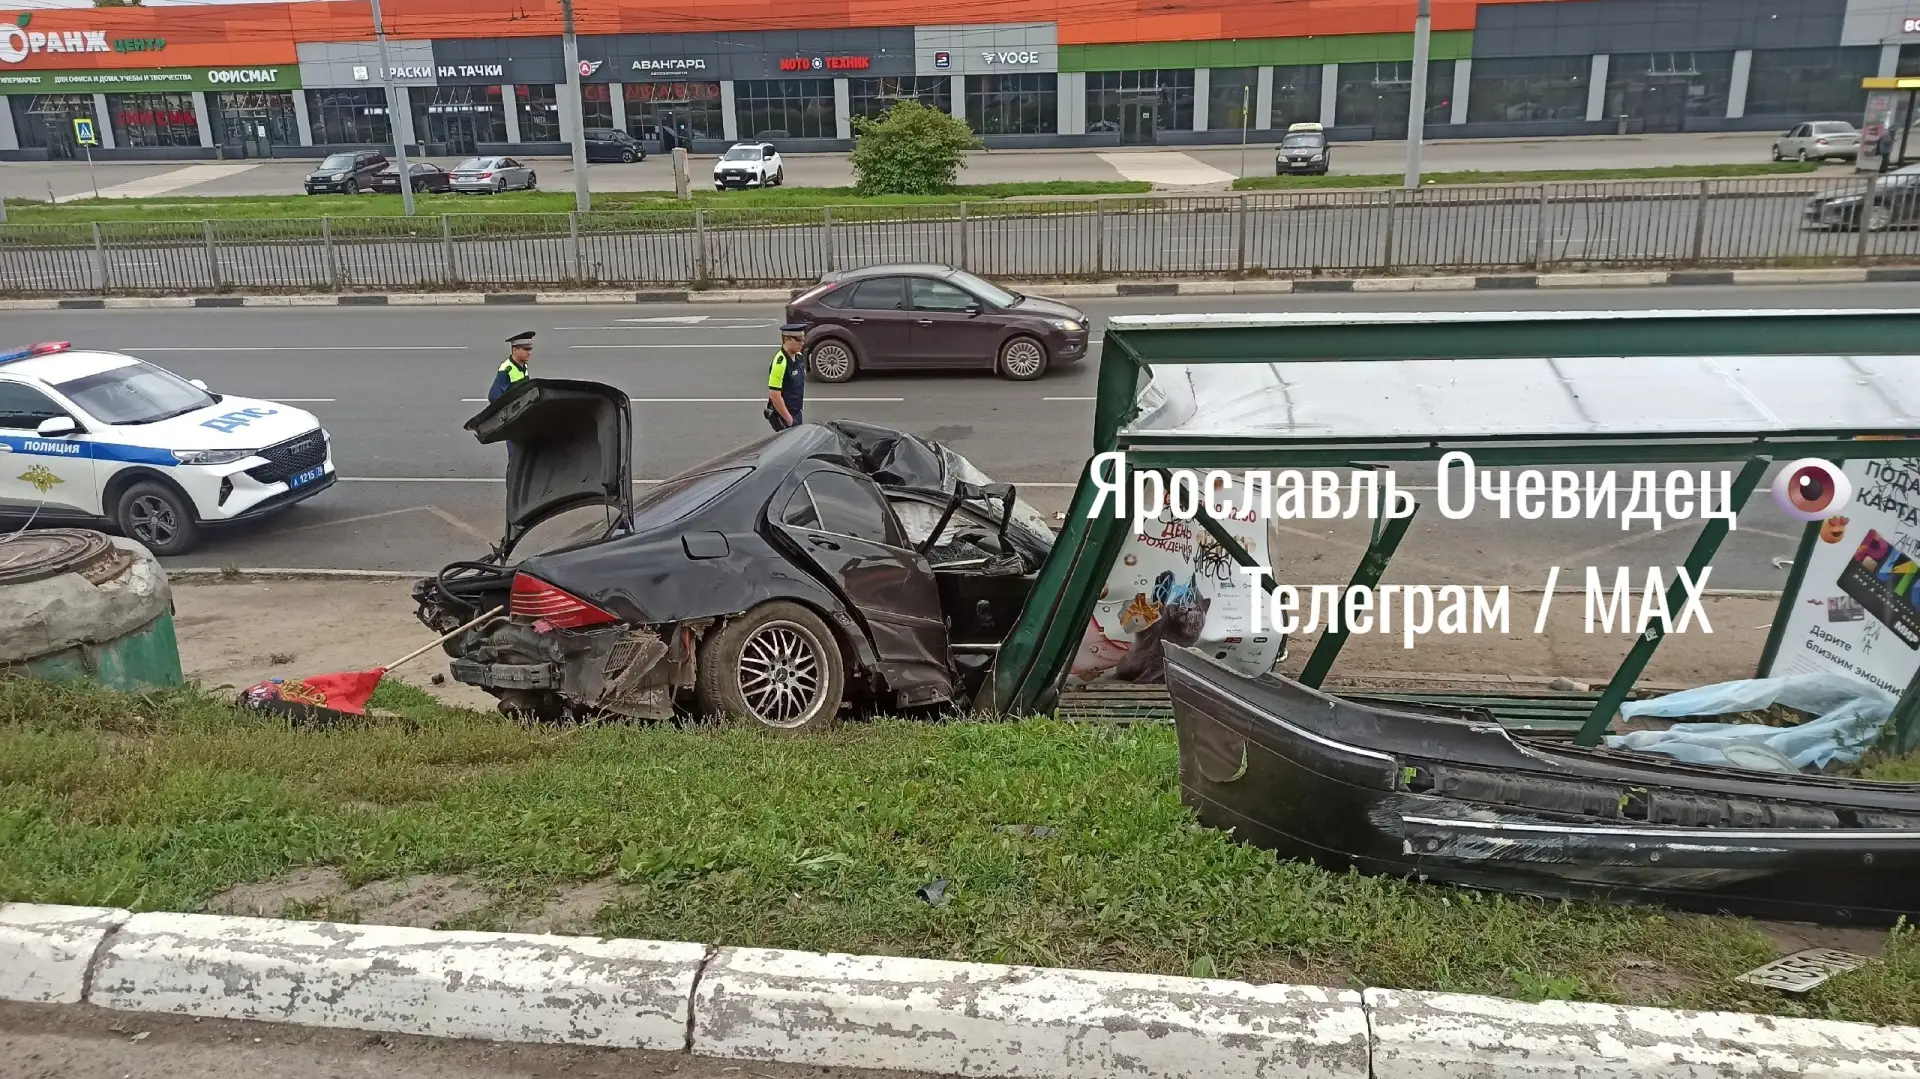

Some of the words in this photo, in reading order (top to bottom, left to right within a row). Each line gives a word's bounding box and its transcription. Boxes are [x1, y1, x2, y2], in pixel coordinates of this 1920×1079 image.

[0, 23, 110, 63] ОРАНЖ
[113, 38, 167, 54] ЦЕНТР
[632, 59, 706, 70] АВАНГАРД
[780, 58, 810, 71] МОТО
[825, 56, 869, 69] ТЕХНИК
[998, 52, 1039, 64] VOGE
[0, 76, 41, 84] ИПЕРМАРКЕТ
[55, 76, 67, 84] ДЛЯ
[208, 69, 278, 84] ОФИСМАГ
[438, 66, 457, 77] НА
[459, 65, 503, 77] ТАЧКИ
[200, 407, 278, 433] ДПС
[24, 440, 80, 454] ПОЛИЦИЯ
[1856, 487, 1918, 526] КАРТА
[1161, 521, 1192, 540] ДЕНЬ
[1137, 533, 1193, 554] РОЖДЕНИЯ
[1809, 624, 1852, 652] Дарите
[1894, 620, 1919, 643] МИР
[1805, 640, 1853, 671] близким
